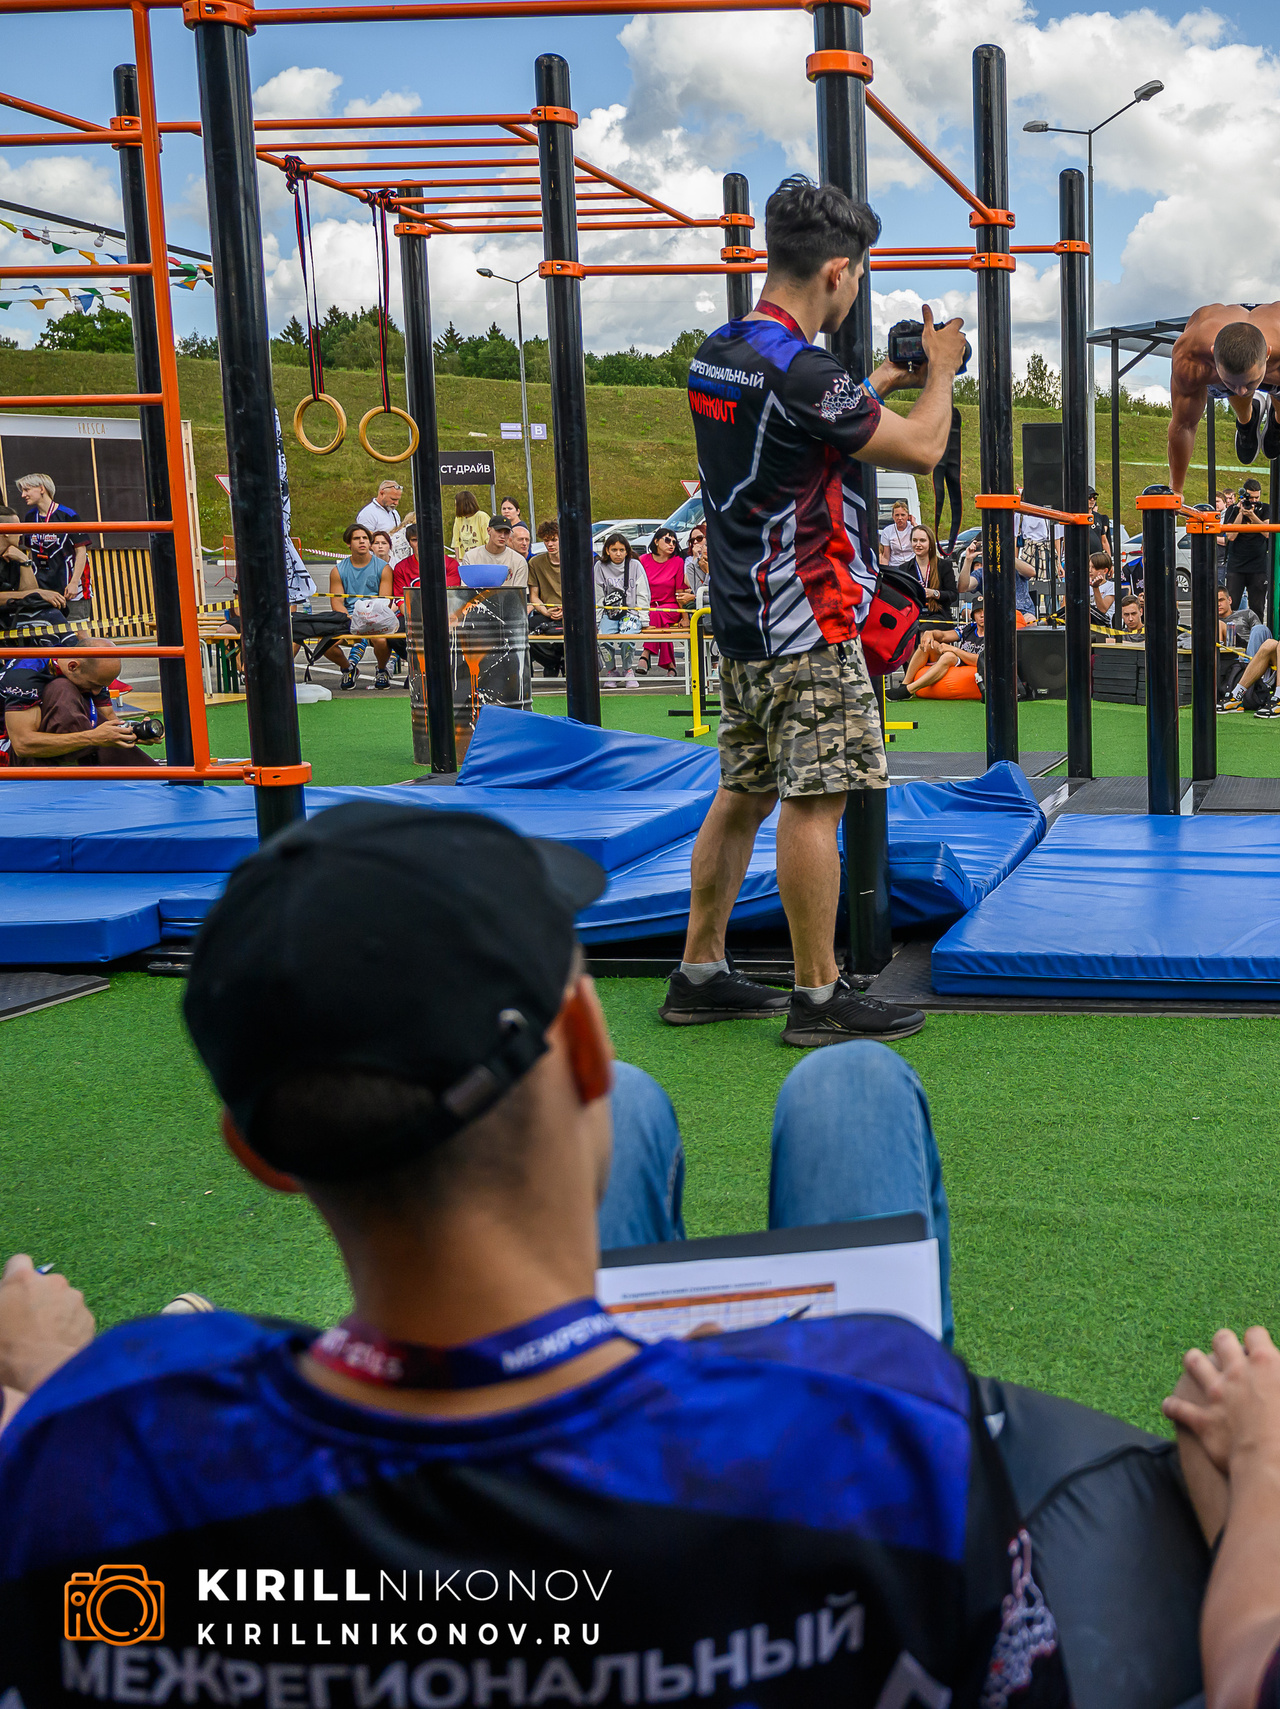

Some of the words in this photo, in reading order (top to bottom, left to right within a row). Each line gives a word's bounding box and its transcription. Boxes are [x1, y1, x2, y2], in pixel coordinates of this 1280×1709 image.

[77, 422, 106, 436] FRESCA
[440, 463, 491, 475] СТ-ДРАЙВ
[60, 1591, 866, 1709] МЕЖРЕГИОНАЛЬНЫЙ
